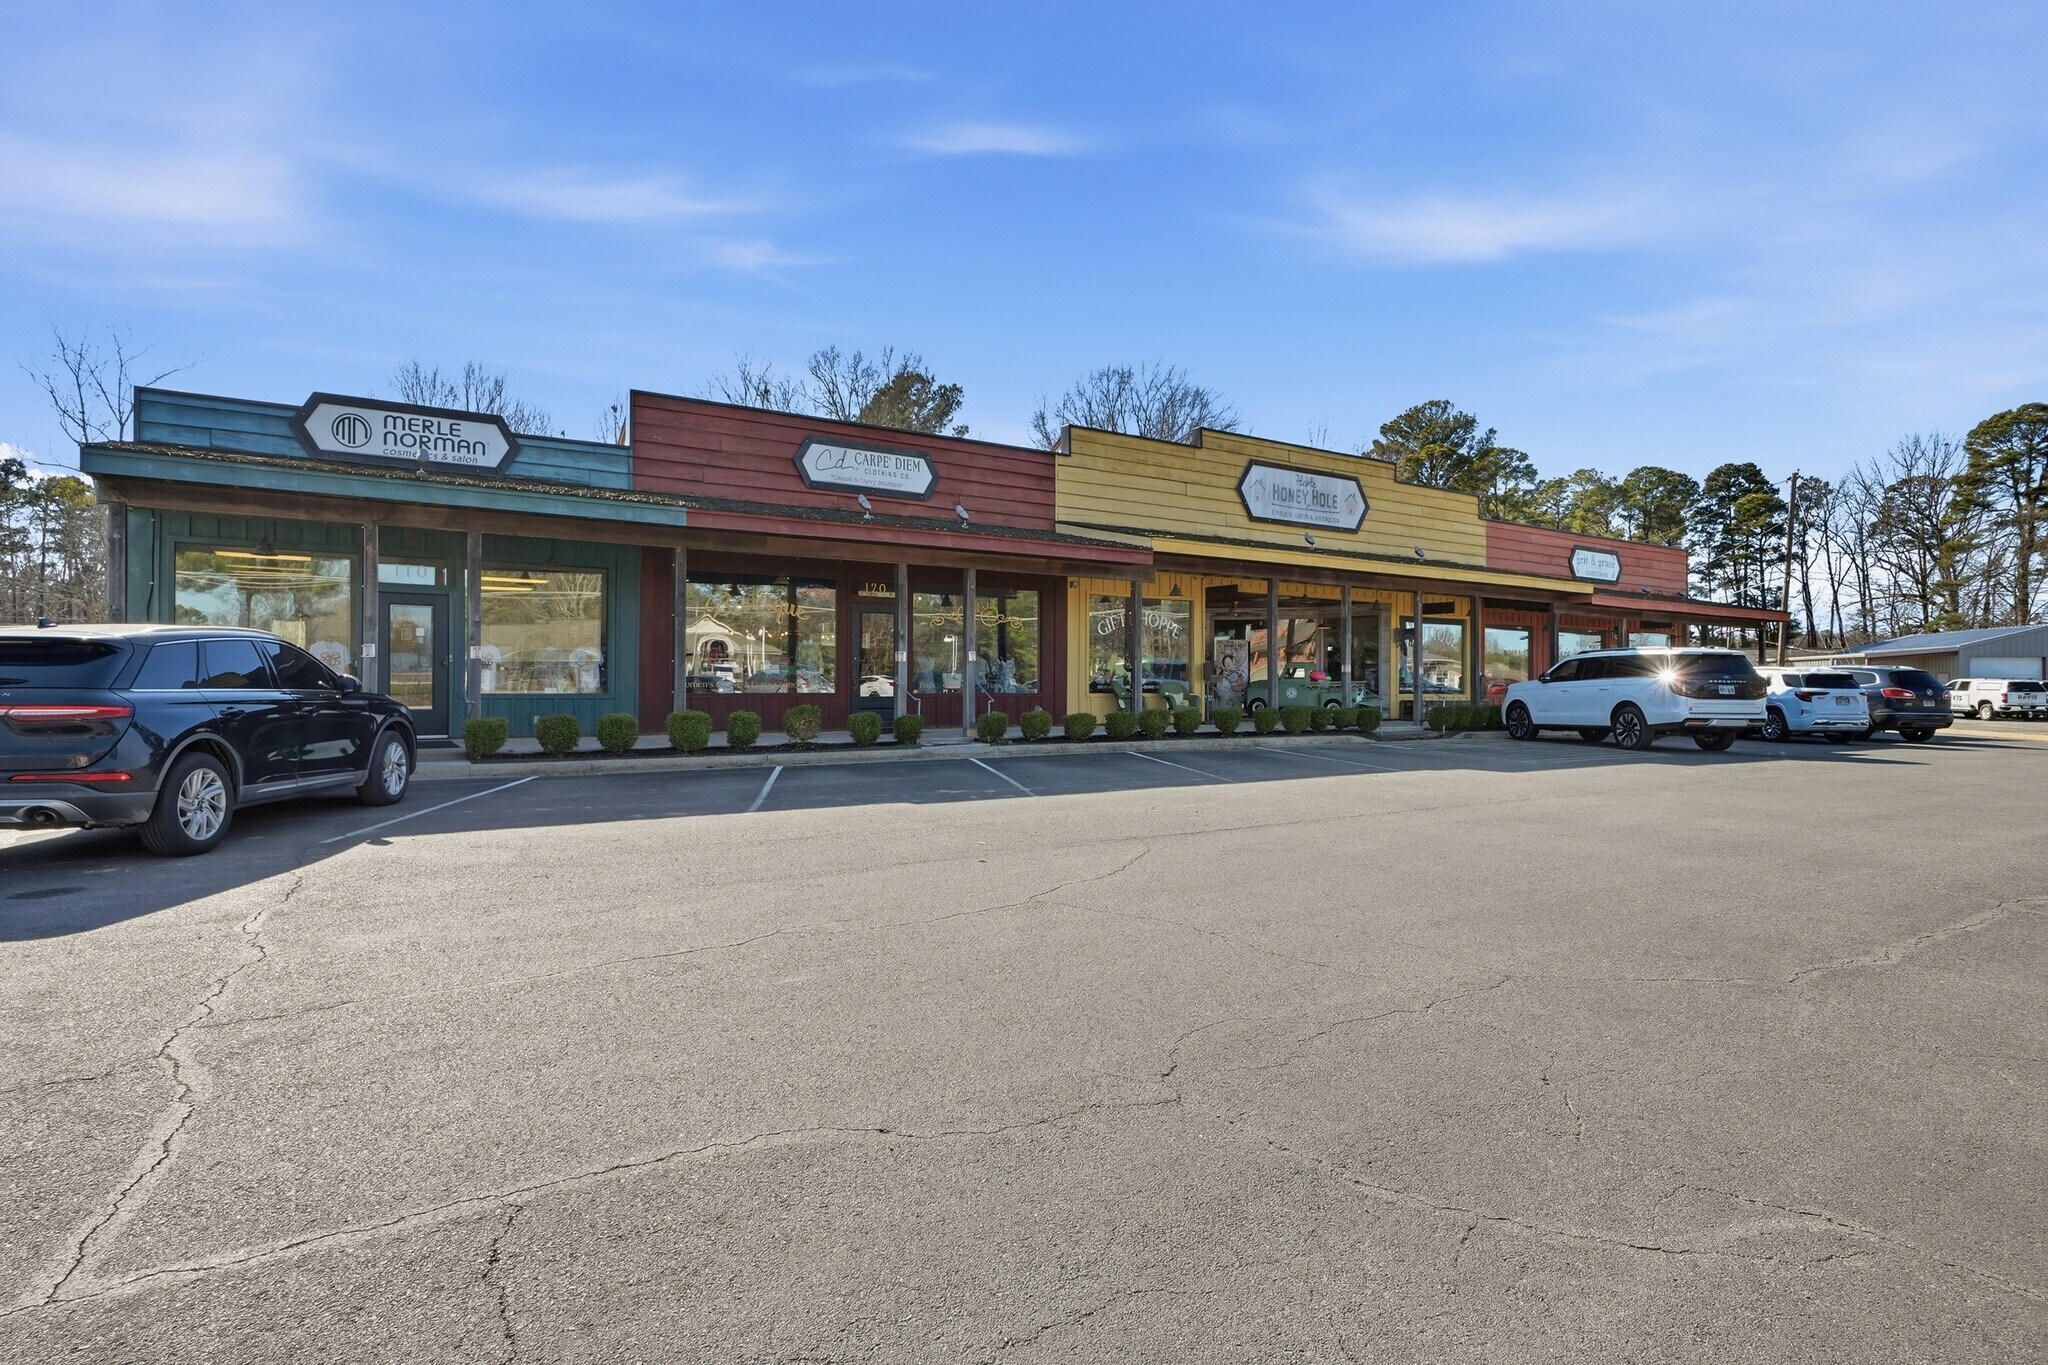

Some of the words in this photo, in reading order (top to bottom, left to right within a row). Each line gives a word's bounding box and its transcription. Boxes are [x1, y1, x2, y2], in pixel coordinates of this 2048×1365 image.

[383, 414, 461, 438] MERLE
[383, 431, 487, 456] NORMAN
[441, 453, 448, 462] &
[452, 455, 478, 464] salon
[895, 457, 921, 473] DIEM
[864, 468, 897, 479] CLOTHING
[1272, 483, 1309, 505] HONEY
[1312, 490, 1338, 509] HOLE
[865, 582, 887, 593] 120
[1097, 613, 1126, 636] GIFT
[1141, 612, 1183, 640] HOPPE
